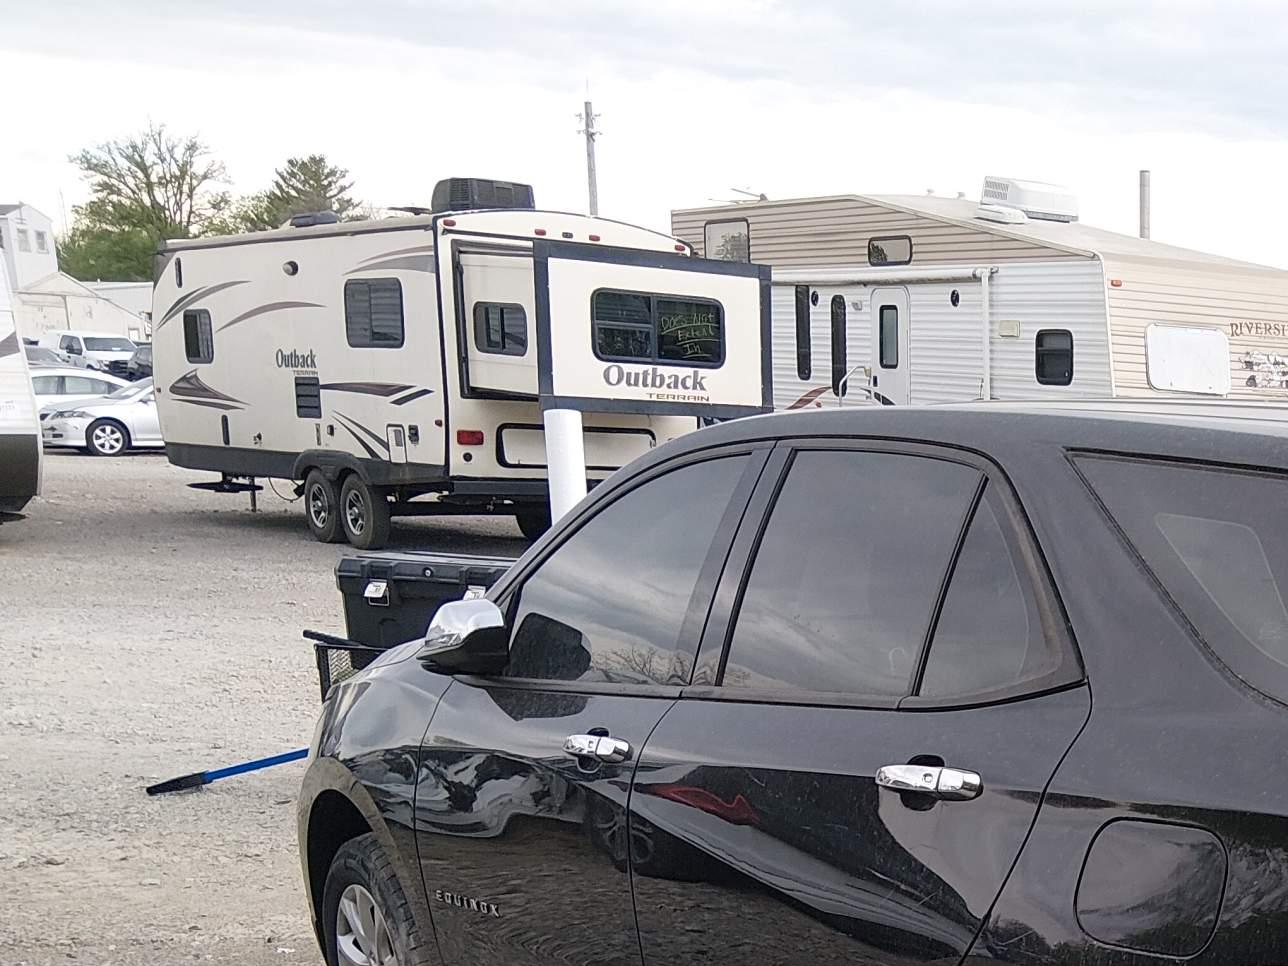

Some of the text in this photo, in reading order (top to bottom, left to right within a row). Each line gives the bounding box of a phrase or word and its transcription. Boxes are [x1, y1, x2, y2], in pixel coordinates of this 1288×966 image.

[275, 348, 317, 369] Outback
[603, 364, 708, 392] Outback
[645, 393, 710, 402] TERRAIN
[435, 889, 500, 918] EQUINOX
